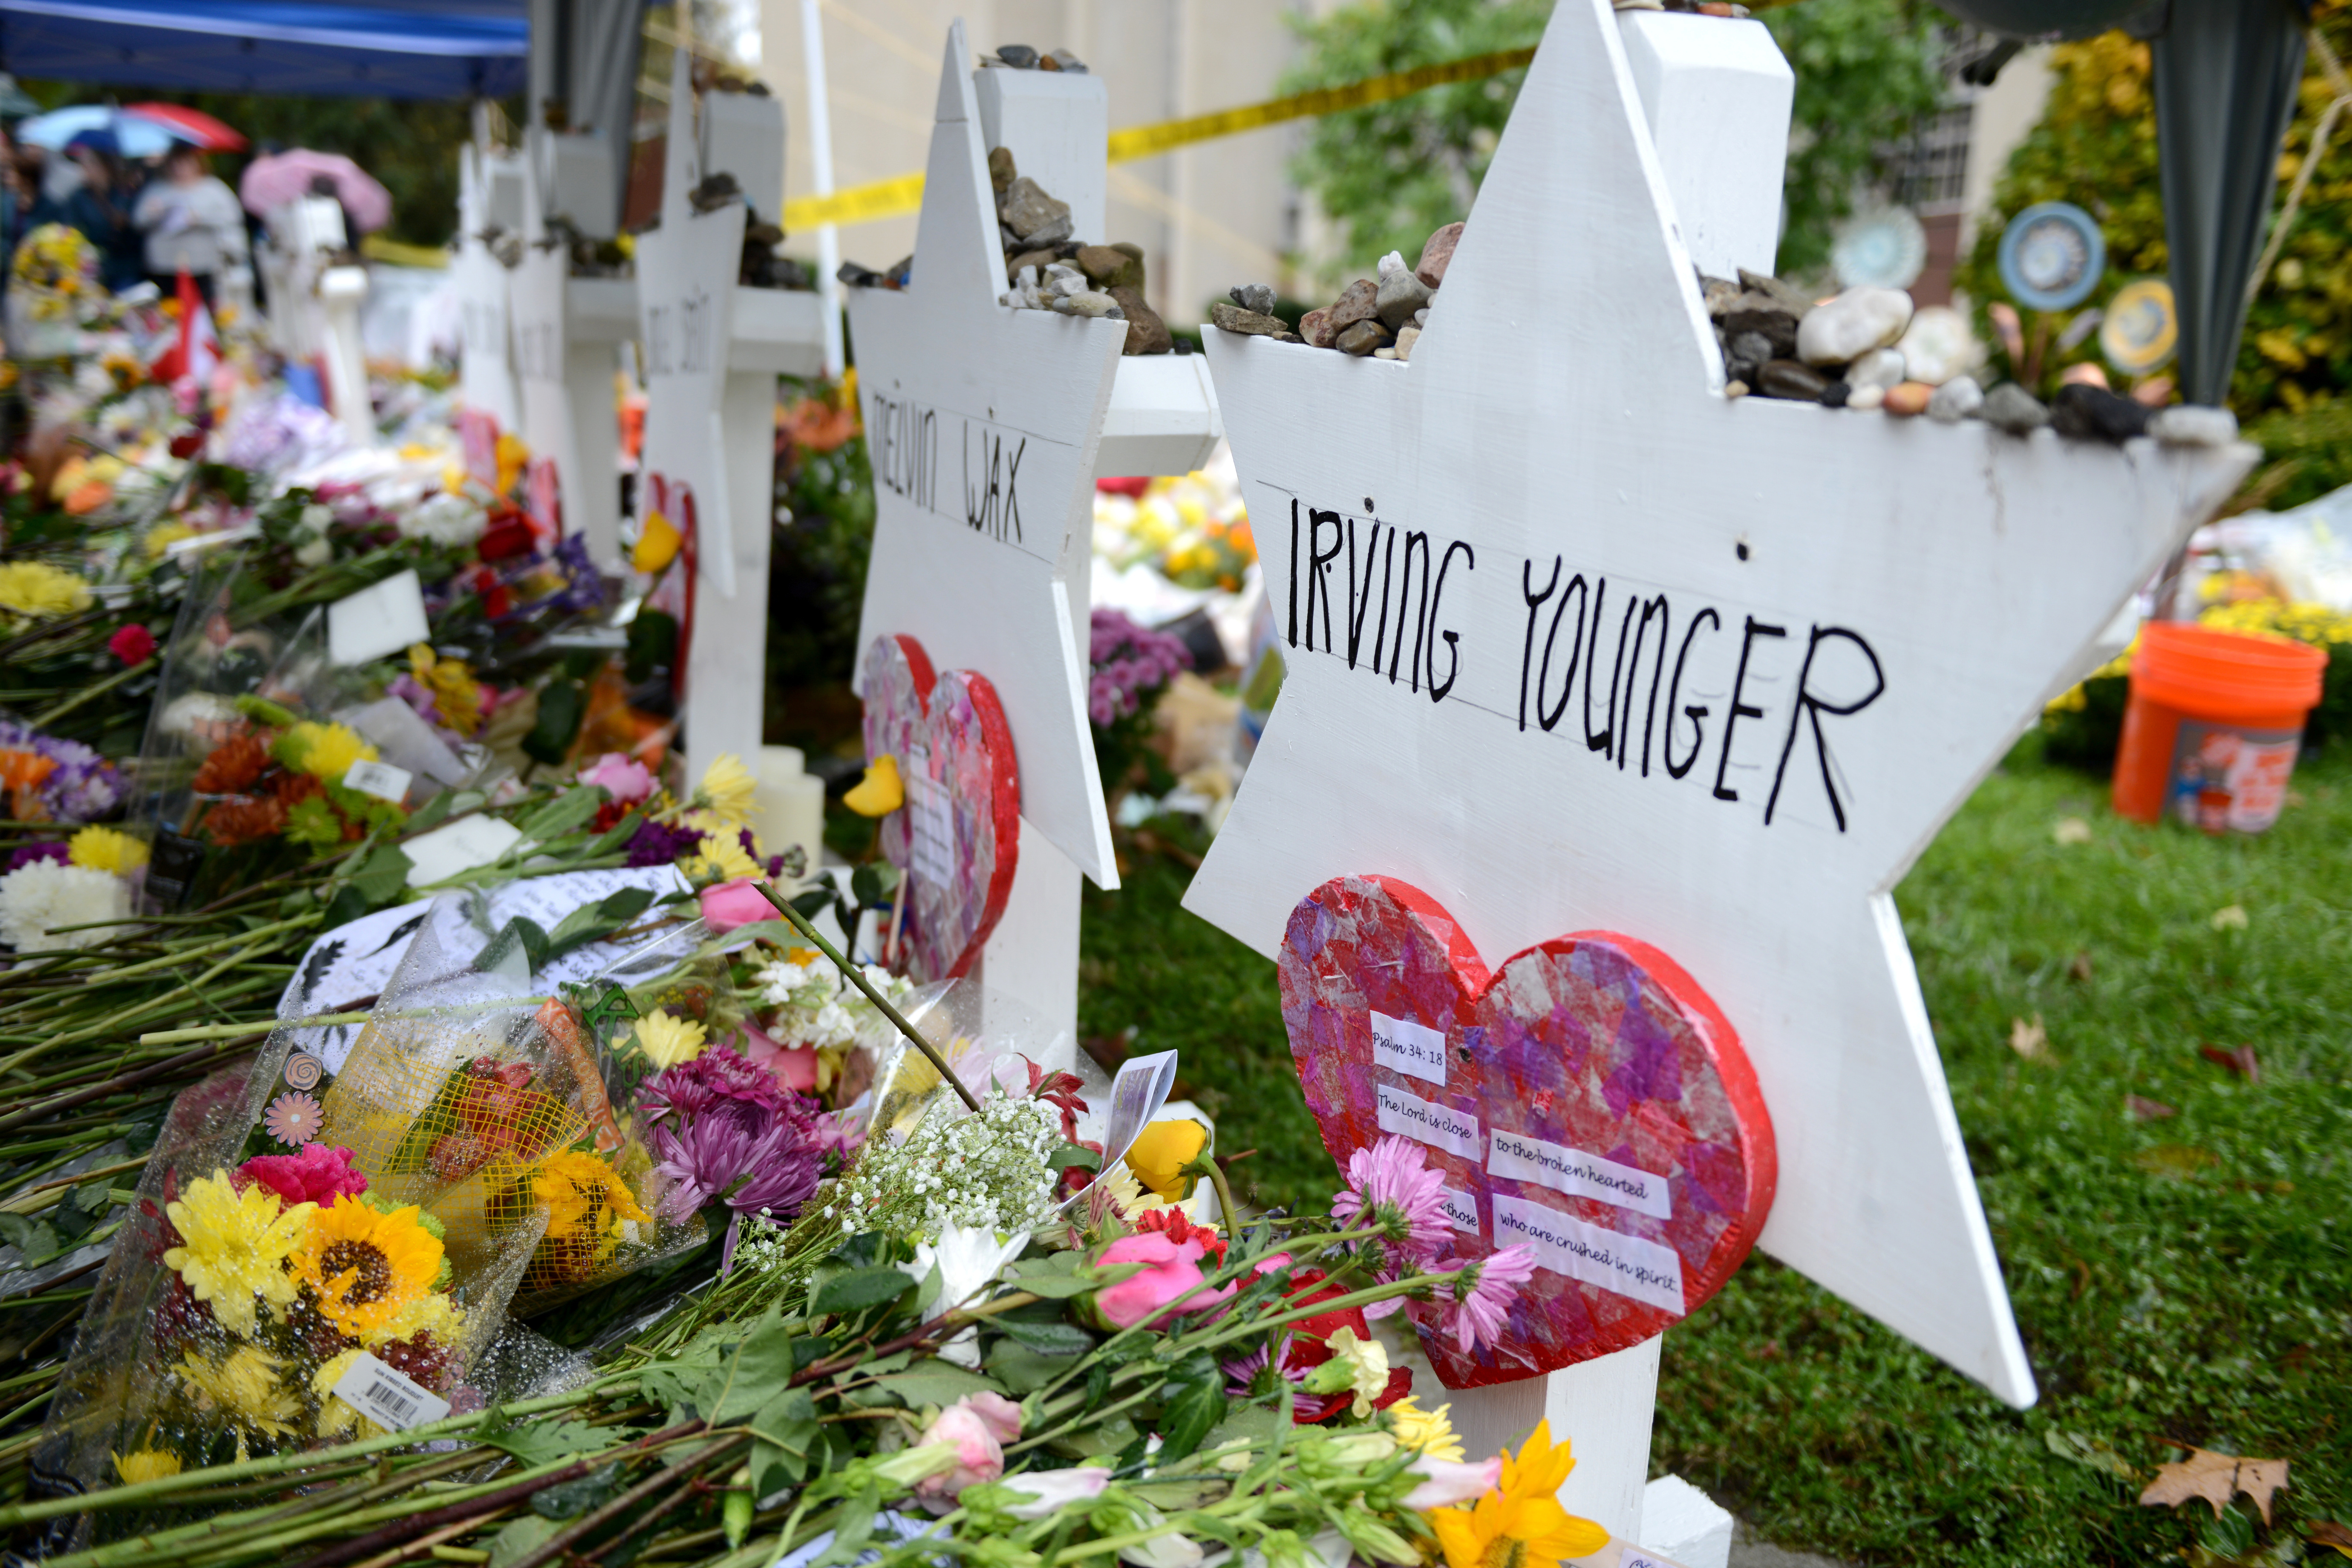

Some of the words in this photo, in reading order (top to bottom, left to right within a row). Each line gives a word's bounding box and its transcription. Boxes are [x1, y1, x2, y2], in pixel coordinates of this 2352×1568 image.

[963, 418, 1026, 544] WAX
[1288, 498, 1474, 703] IRVING
[1519, 554, 1884, 832] YOUNGER
[1372, 1032, 1406, 1054] Psalm
[1430, 1051, 1442, 1065] 18
[1378, 1094, 1400, 1111] The
[1402, 1102, 1427, 1123] Lord
[1430, 1114, 1441, 1128] is
[1443, 1118, 1472, 1139] close
[1496, 1137, 1512, 1152] to
[1513, 1142, 1536, 1161] the
[1536, 1148, 1586, 1178] broken
[1588, 1165, 1649, 1199] hearted
[1447, 1202, 1478, 1226] those
[1500, 1213, 1528, 1232] who
[1529, 1225, 1554, 1242] are
[1556, 1236, 1614, 1265] crushed
[1616, 1256, 1633, 1274] in
[1635, 1266, 1678, 1294] spirit.
[374, 1368, 385, 1378] SUN
[385, 1374, 402, 1388] KISSED
[401, 1385, 424, 1401] BOUQUET
